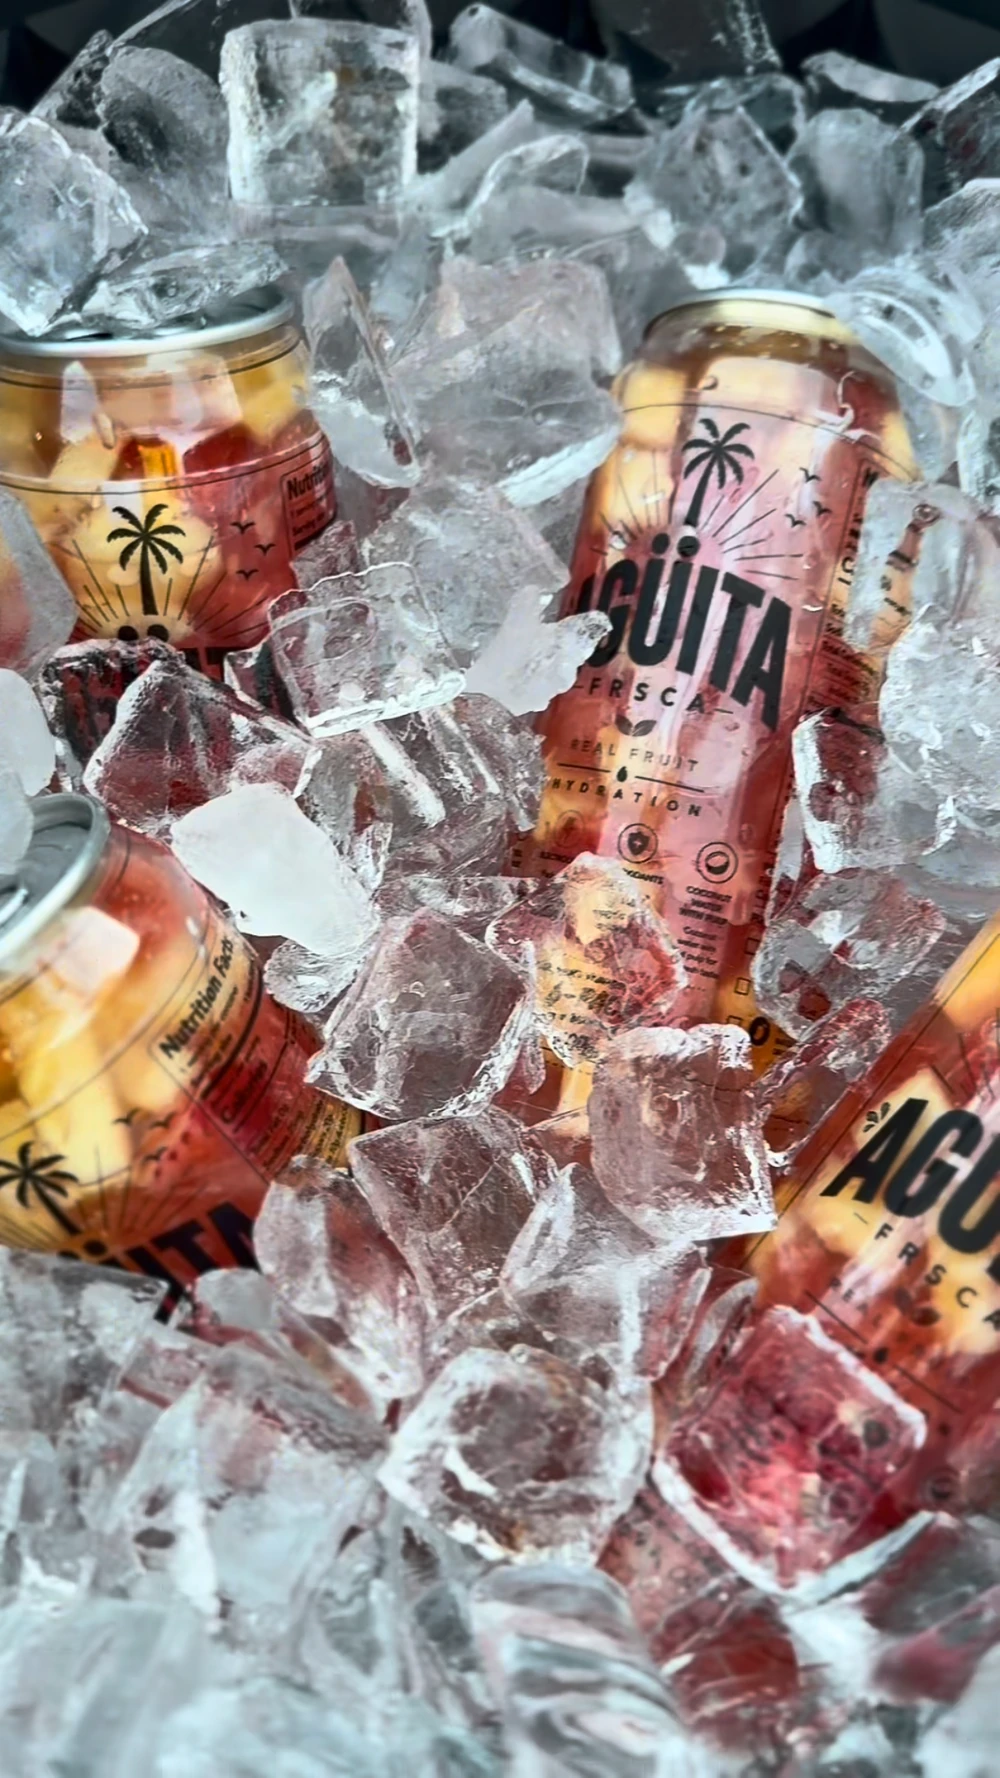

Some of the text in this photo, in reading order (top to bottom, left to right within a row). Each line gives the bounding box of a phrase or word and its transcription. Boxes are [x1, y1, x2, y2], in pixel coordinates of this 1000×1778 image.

[567, 532, 792, 733] GÜITA
[588, 677, 706, 714] FRSCA
[570, 738, 700, 773] REAL FRUIT
[551, 776, 702, 818] HYDRATION
[158, 936, 234, 1059] Nutrition Facts
